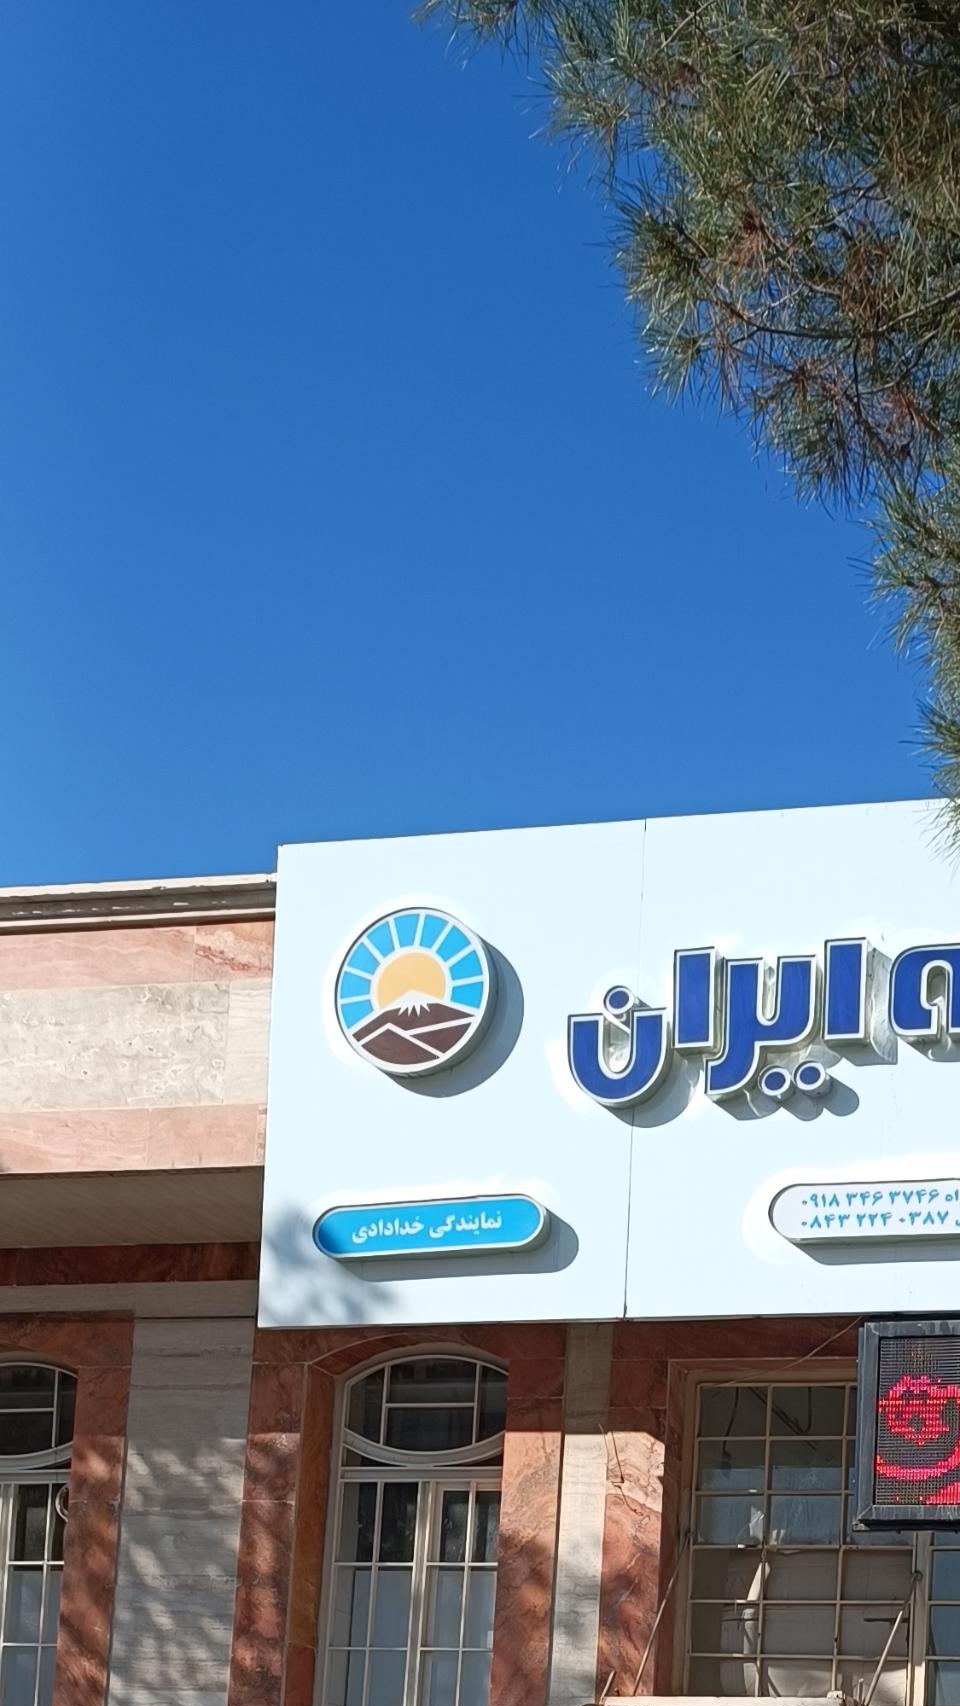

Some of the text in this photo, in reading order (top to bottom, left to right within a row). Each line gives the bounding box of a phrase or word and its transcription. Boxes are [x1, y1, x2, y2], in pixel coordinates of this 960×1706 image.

[567, 937, 868, 1104] ایران
[802, 1193, 840, 1208] ۰۹۱۸
[846, 1191, 883, 1207] ۳۴۶
[889, 1189, 940, 1205] ۳۷۴۶
[352, 1211, 502, 1244] نمایندگی خدادادی
[801, 1213, 850, 1229] ۰۸۴۳
[856, 1212, 893, 1228] ۲۲۴
[899, 1210, 949, 1226] ۰۳۸۷
